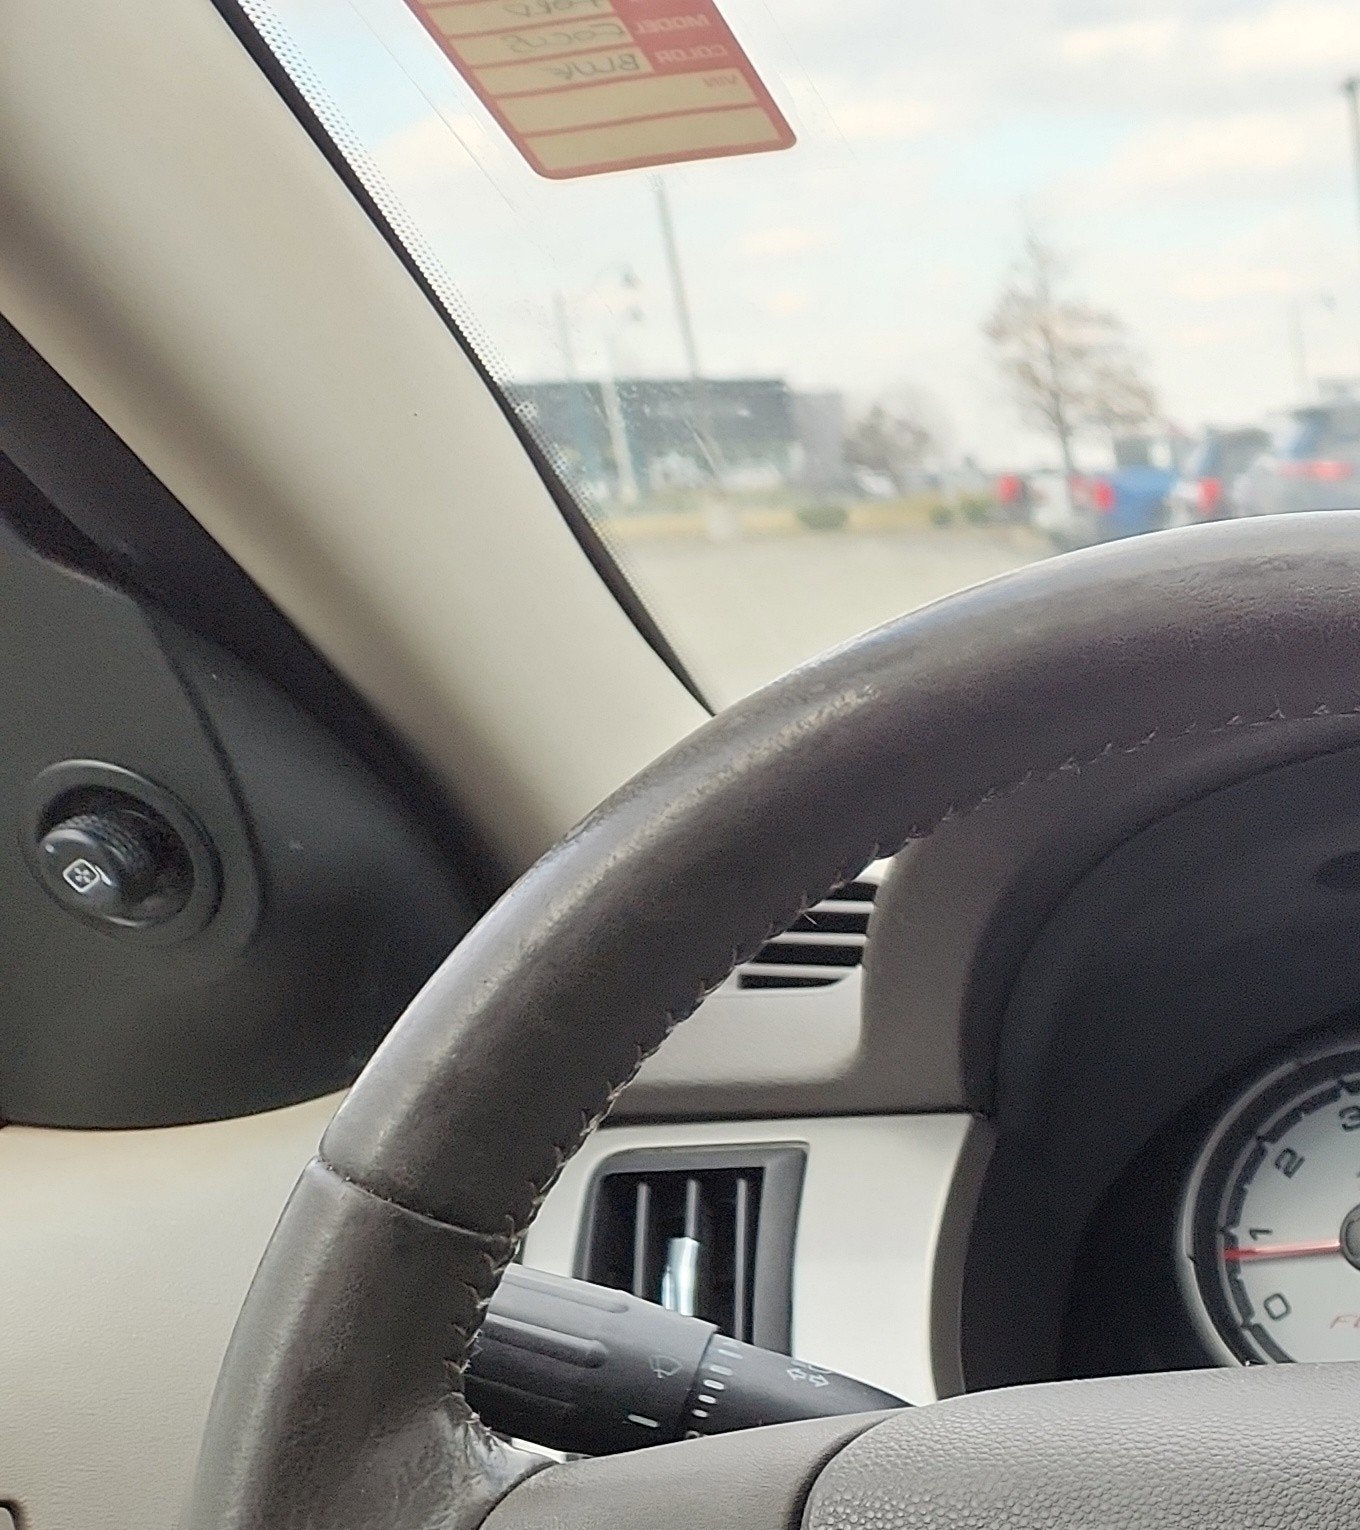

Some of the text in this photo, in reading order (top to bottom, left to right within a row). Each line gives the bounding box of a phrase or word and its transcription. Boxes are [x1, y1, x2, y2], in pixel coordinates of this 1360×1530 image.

[1274, 1148, 1305, 1179] 2
[1249, 1227, 1273, 1241] 1
[1263, 1292, 1292, 1321] 0
